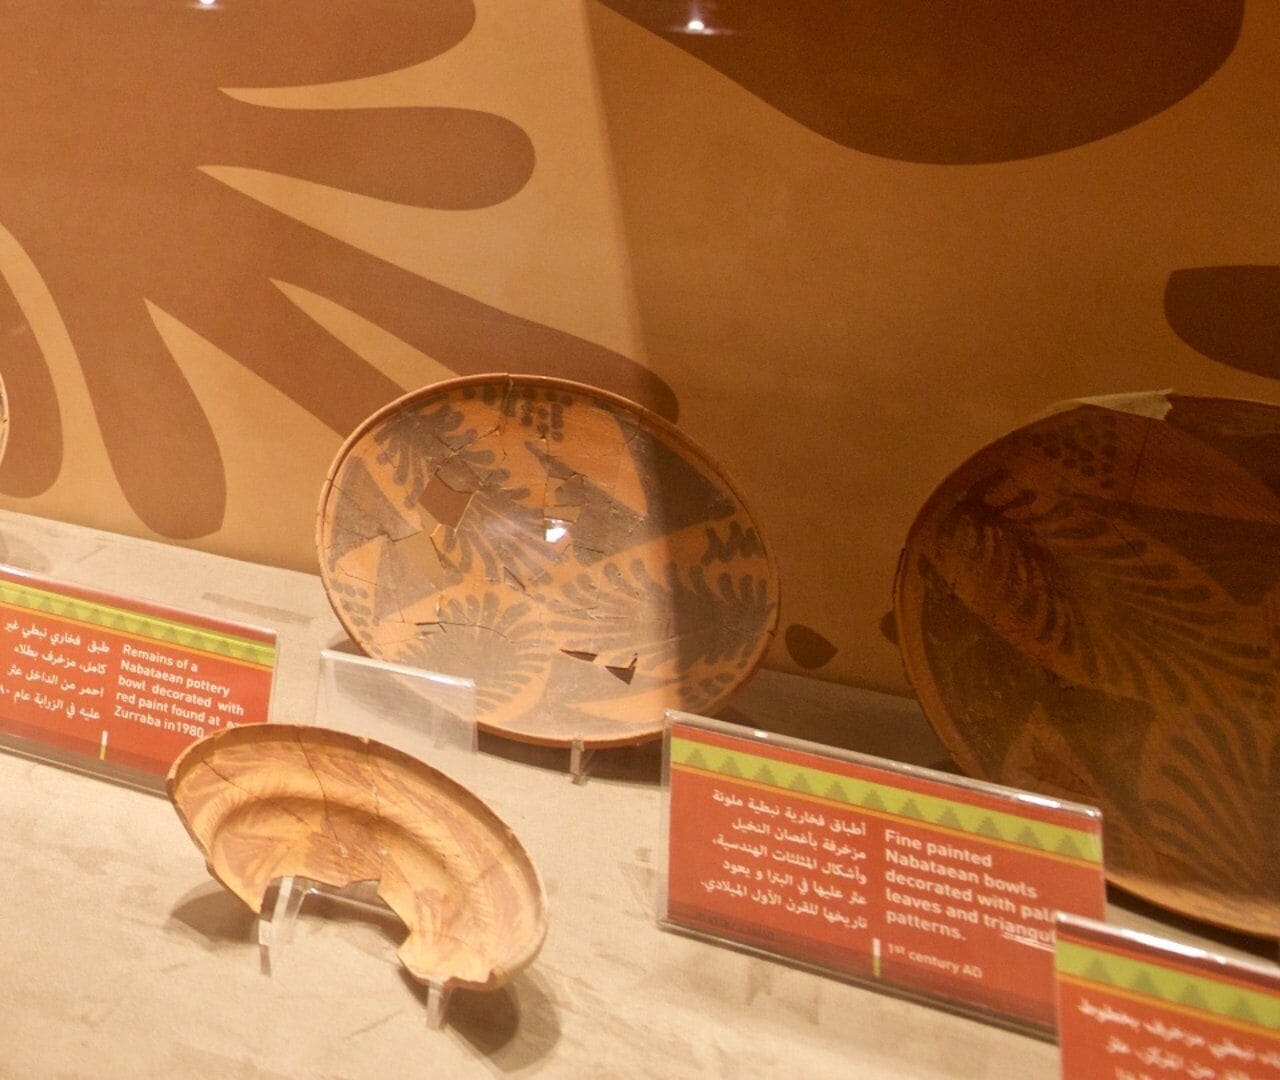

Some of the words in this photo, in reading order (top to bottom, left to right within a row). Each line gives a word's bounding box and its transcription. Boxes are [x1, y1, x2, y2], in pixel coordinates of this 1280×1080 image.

[4, 620, 19, 632] غير
[22, 624, 48, 640] نبطي
[50, 632, 81, 646] فخاري
[87, 641, 110, 654] طبق
[14, 643, 39, 661] بطلاء
[41, 651, 77, 668] مزخرف
[122, 644, 174, 666] Remains
[176, 658, 189, 670] of
[190, 663, 199, 673] a
[7, 664, 22, 676] عثر
[25, 668, 58, 685] الداخل
[120, 659, 184, 685] Nabataean
[186, 677, 231, 698] pottery
[61, 680, 76, 692] من
[118, 675, 146, 691] bowl
[151, 684, 212, 708] decorated
[217, 701, 245, 716] with
[14, 689, 31, 704] عام
[66, 702, 76, 719] في
[79, 706, 101, 721] عليه
[114, 705, 161, 728] Zurraba
[116, 691, 136, 705] red
[138, 697, 169, 713] paint
[171, 703, 205, 723] found
[207, 715, 221, 727] at
[712, 789, 744, 807] ملونة
[747, 797, 781, 816] نبطية
[732, 817, 771, 835] النخيل
[784, 806, 826, 827] فخارية
[830, 819, 867, 837] أطباق
[774, 828, 818, 851] بأغصان
[885, 829, 922, 850] Fine
[926, 842, 993, 868] painted
[822, 838, 867, 861] مزخرفة
[772, 849, 818, 870] المثلثات
[722, 860, 751, 879] يعود
[755, 869, 764, 881] و
[767, 870, 793, 888] البترا
[821, 863, 868, 885] وأشكال
[885, 849, 979, 884] Nabataean
[983, 873, 1038, 899] bowls
[797, 877, 809, 896] في
[813, 880, 844, 900] عليها
[751, 889, 782, 905] الأول
[847, 891, 867, 905] عثر
[885, 870, 973, 903] decorated
[977, 893, 1016, 913] with
[1020, 905, 1049, 923] pal
[886, 888, 942, 914] leaves
[946, 906, 978, 924] and
[785, 898, 819, 916] للقرن
[823, 907, 868, 930] تاريخها
[886, 910, 967, 941] patterns.
[888, 943, 905, 955] 1st
[908, 951, 961, 973] century
[963, 965, 983, 979] AD
